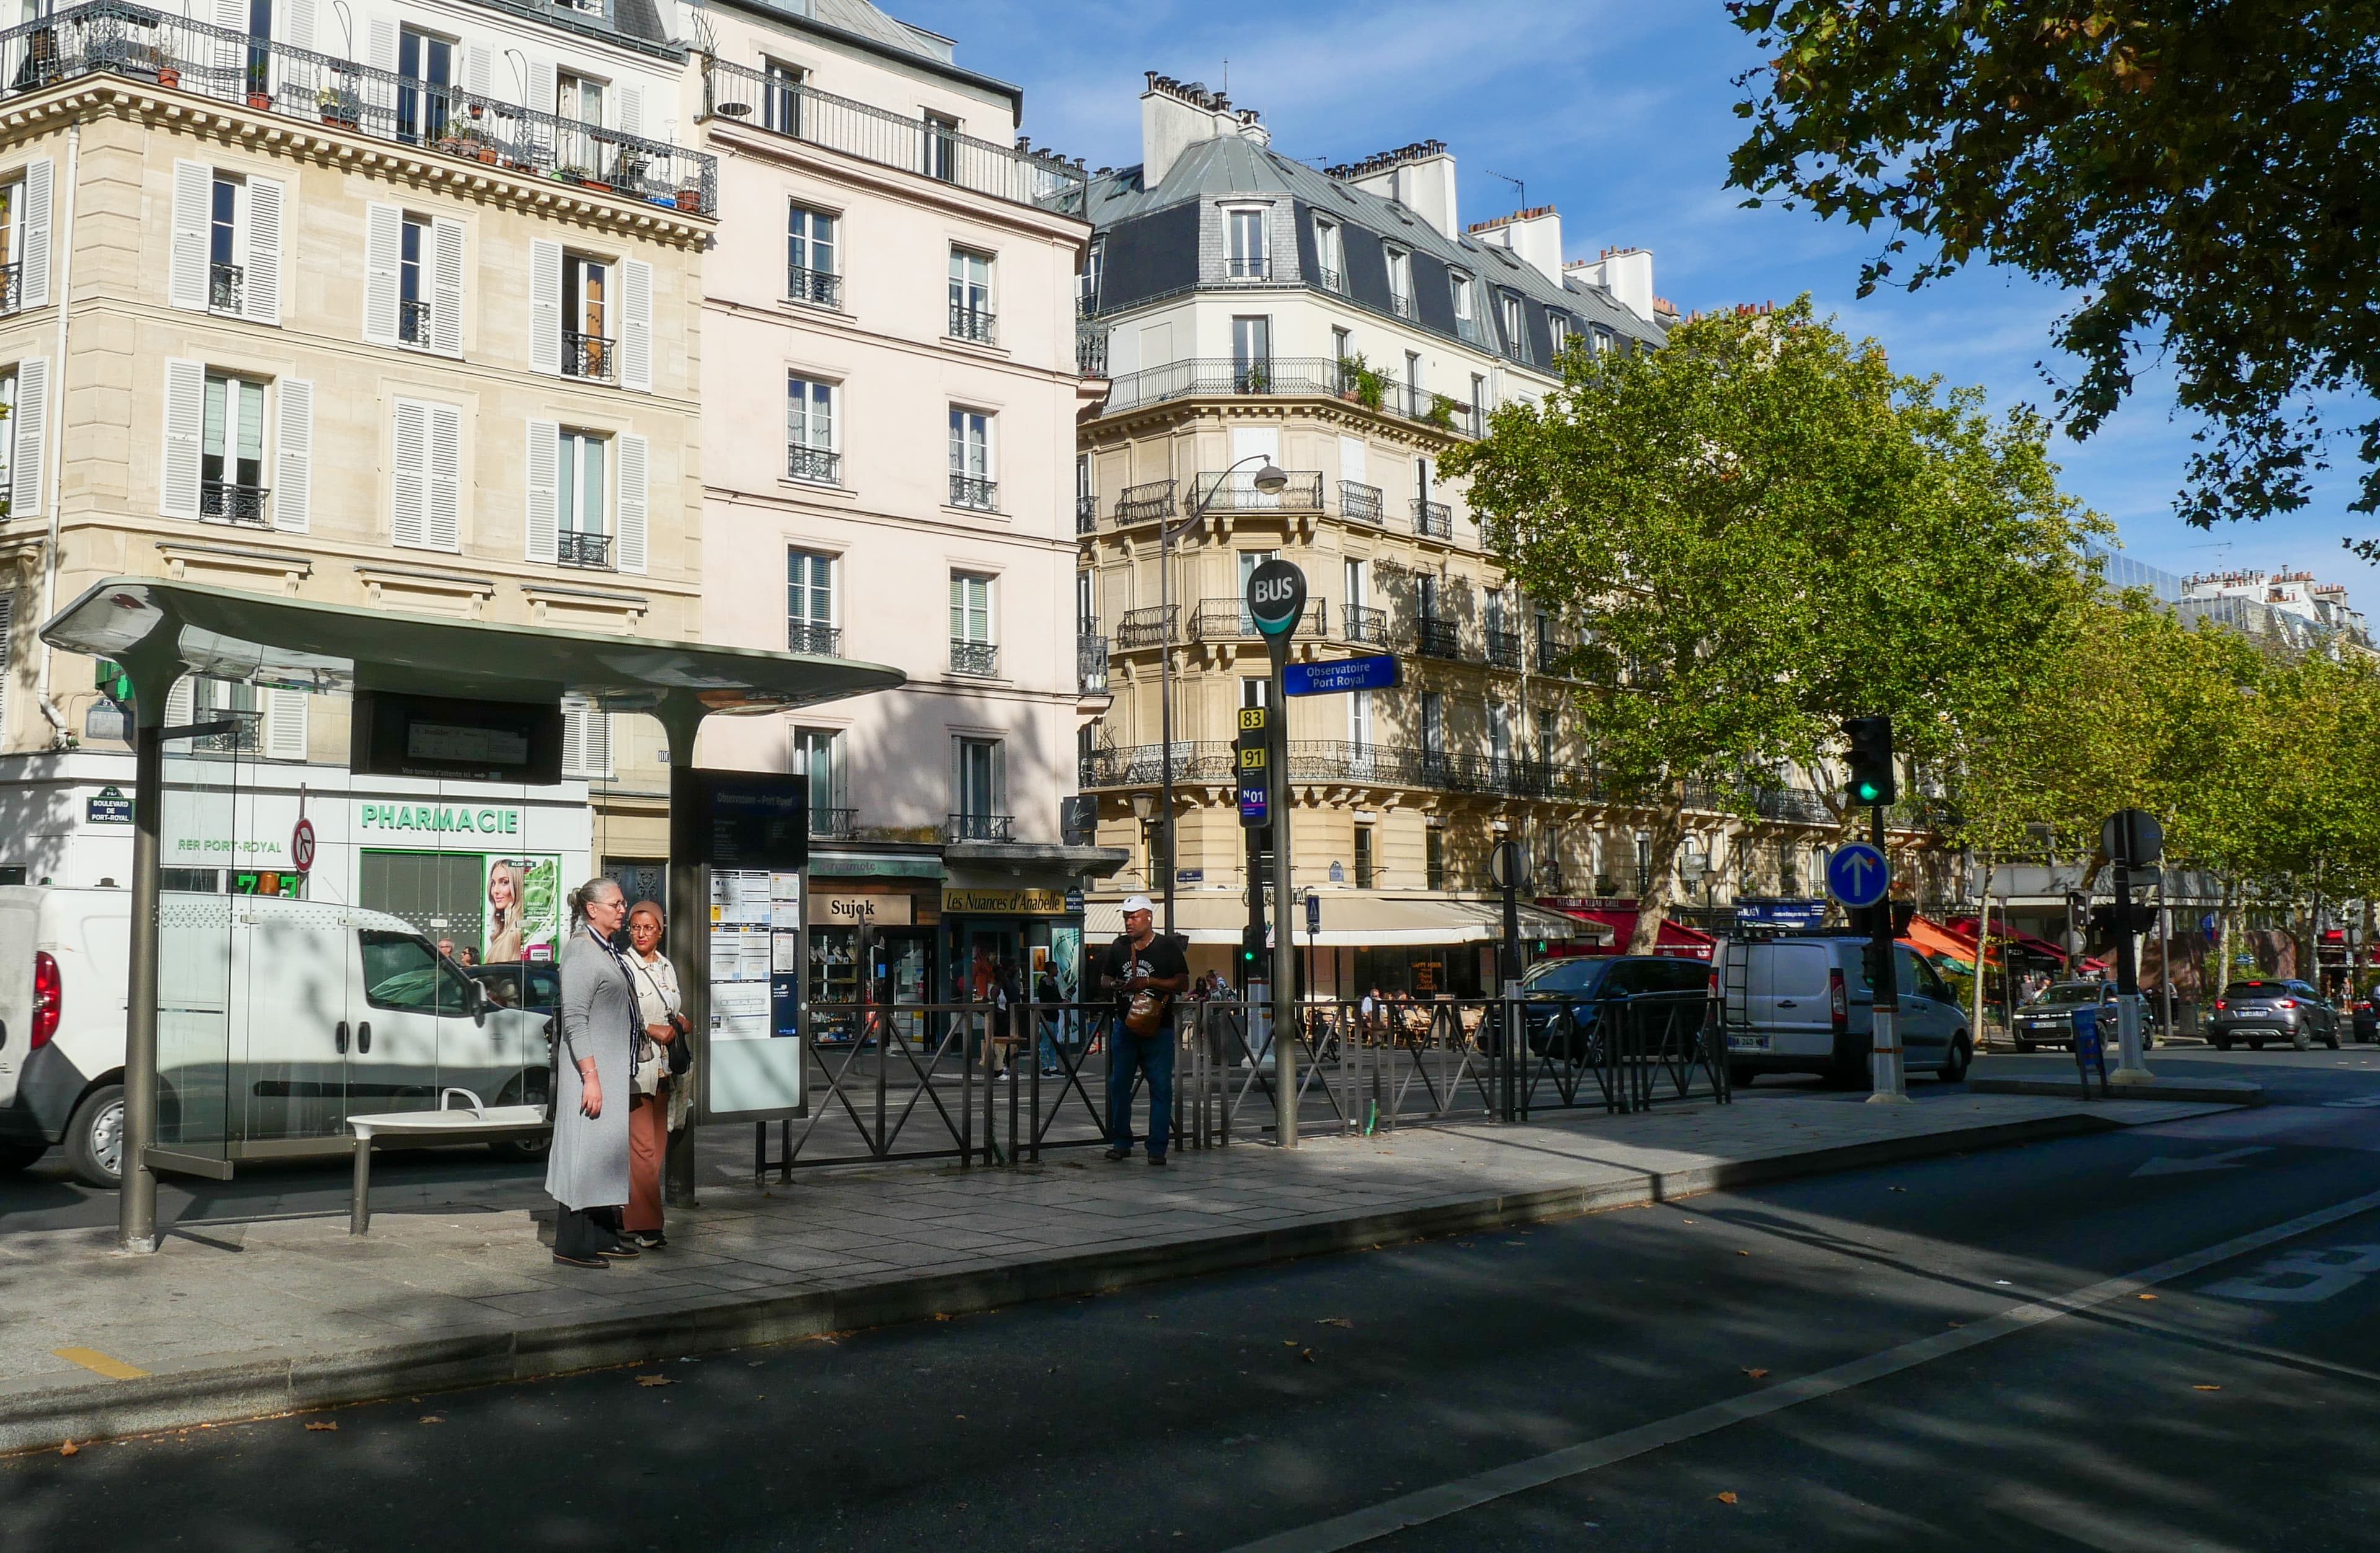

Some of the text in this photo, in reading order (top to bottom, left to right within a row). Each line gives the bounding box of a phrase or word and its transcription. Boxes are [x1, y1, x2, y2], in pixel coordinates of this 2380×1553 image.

[1255, 577, 1293, 603] BUS
[1307, 663, 1370, 678] Observatoire
[1313, 674, 1365, 688] Port Royal
[1244, 712, 1261, 727] 83
[1245, 750, 1261, 766] 91
[435, 769, 462, 777] d'attente
[1243, 790, 1263, 803] N01
[361, 805, 518, 834] PHARMACIE
[178, 839, 200, 851] RER
[831, 900, 875, 918] Sujok
[947, 892, 1060, 911] Les Nuances d'Anabelle
